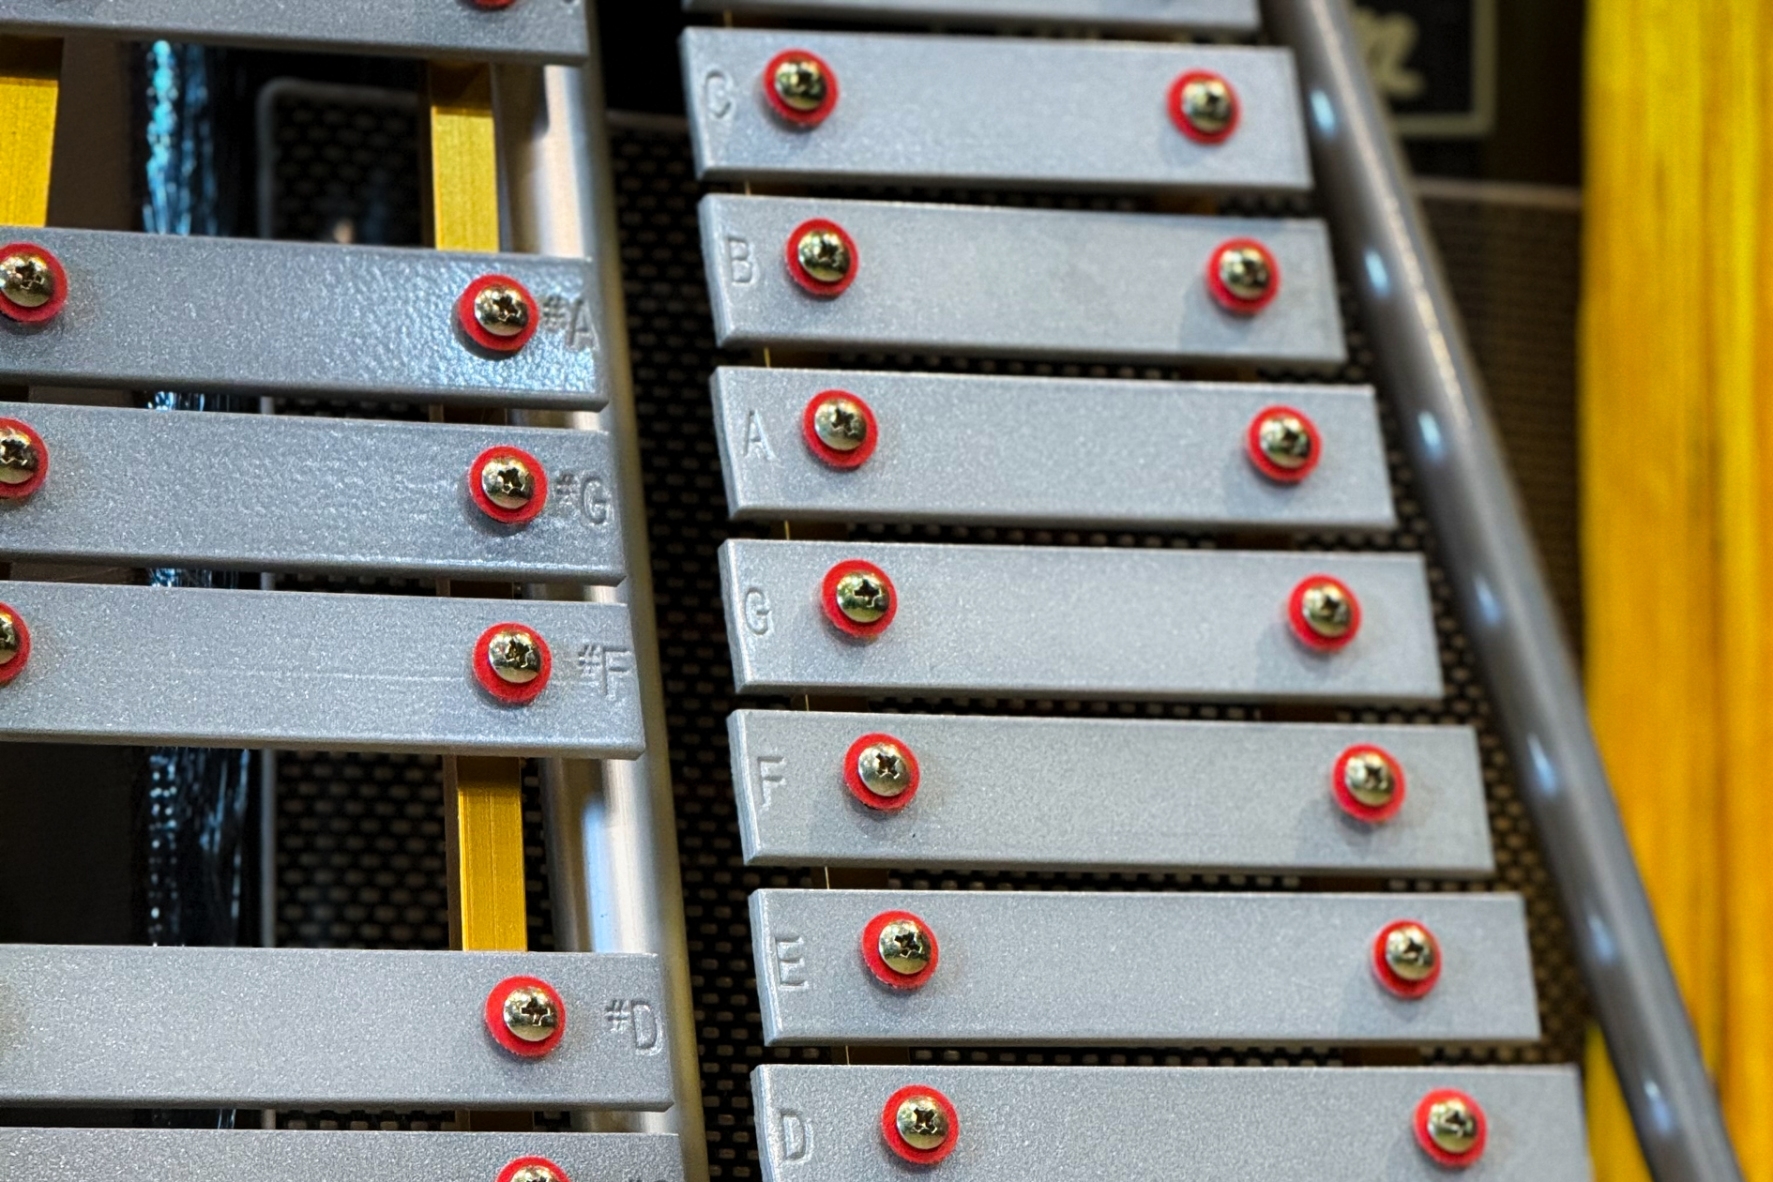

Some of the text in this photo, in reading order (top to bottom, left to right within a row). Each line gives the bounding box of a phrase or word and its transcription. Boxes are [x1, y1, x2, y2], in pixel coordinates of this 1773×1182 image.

[705, 69, 732, 119] C
[727, 236, 759, 285] B
[743, 409, 776, 461] A
[556, 469, 613, 526] #G
[745, 587, 772, 636] G
[578, 644, 632, 700] #F
[757, 755, 786, 810] F
[775, 935, 809, 989] E
[605, 998, 663, 1056] #D
[780, 1108, 813, 1165] D
